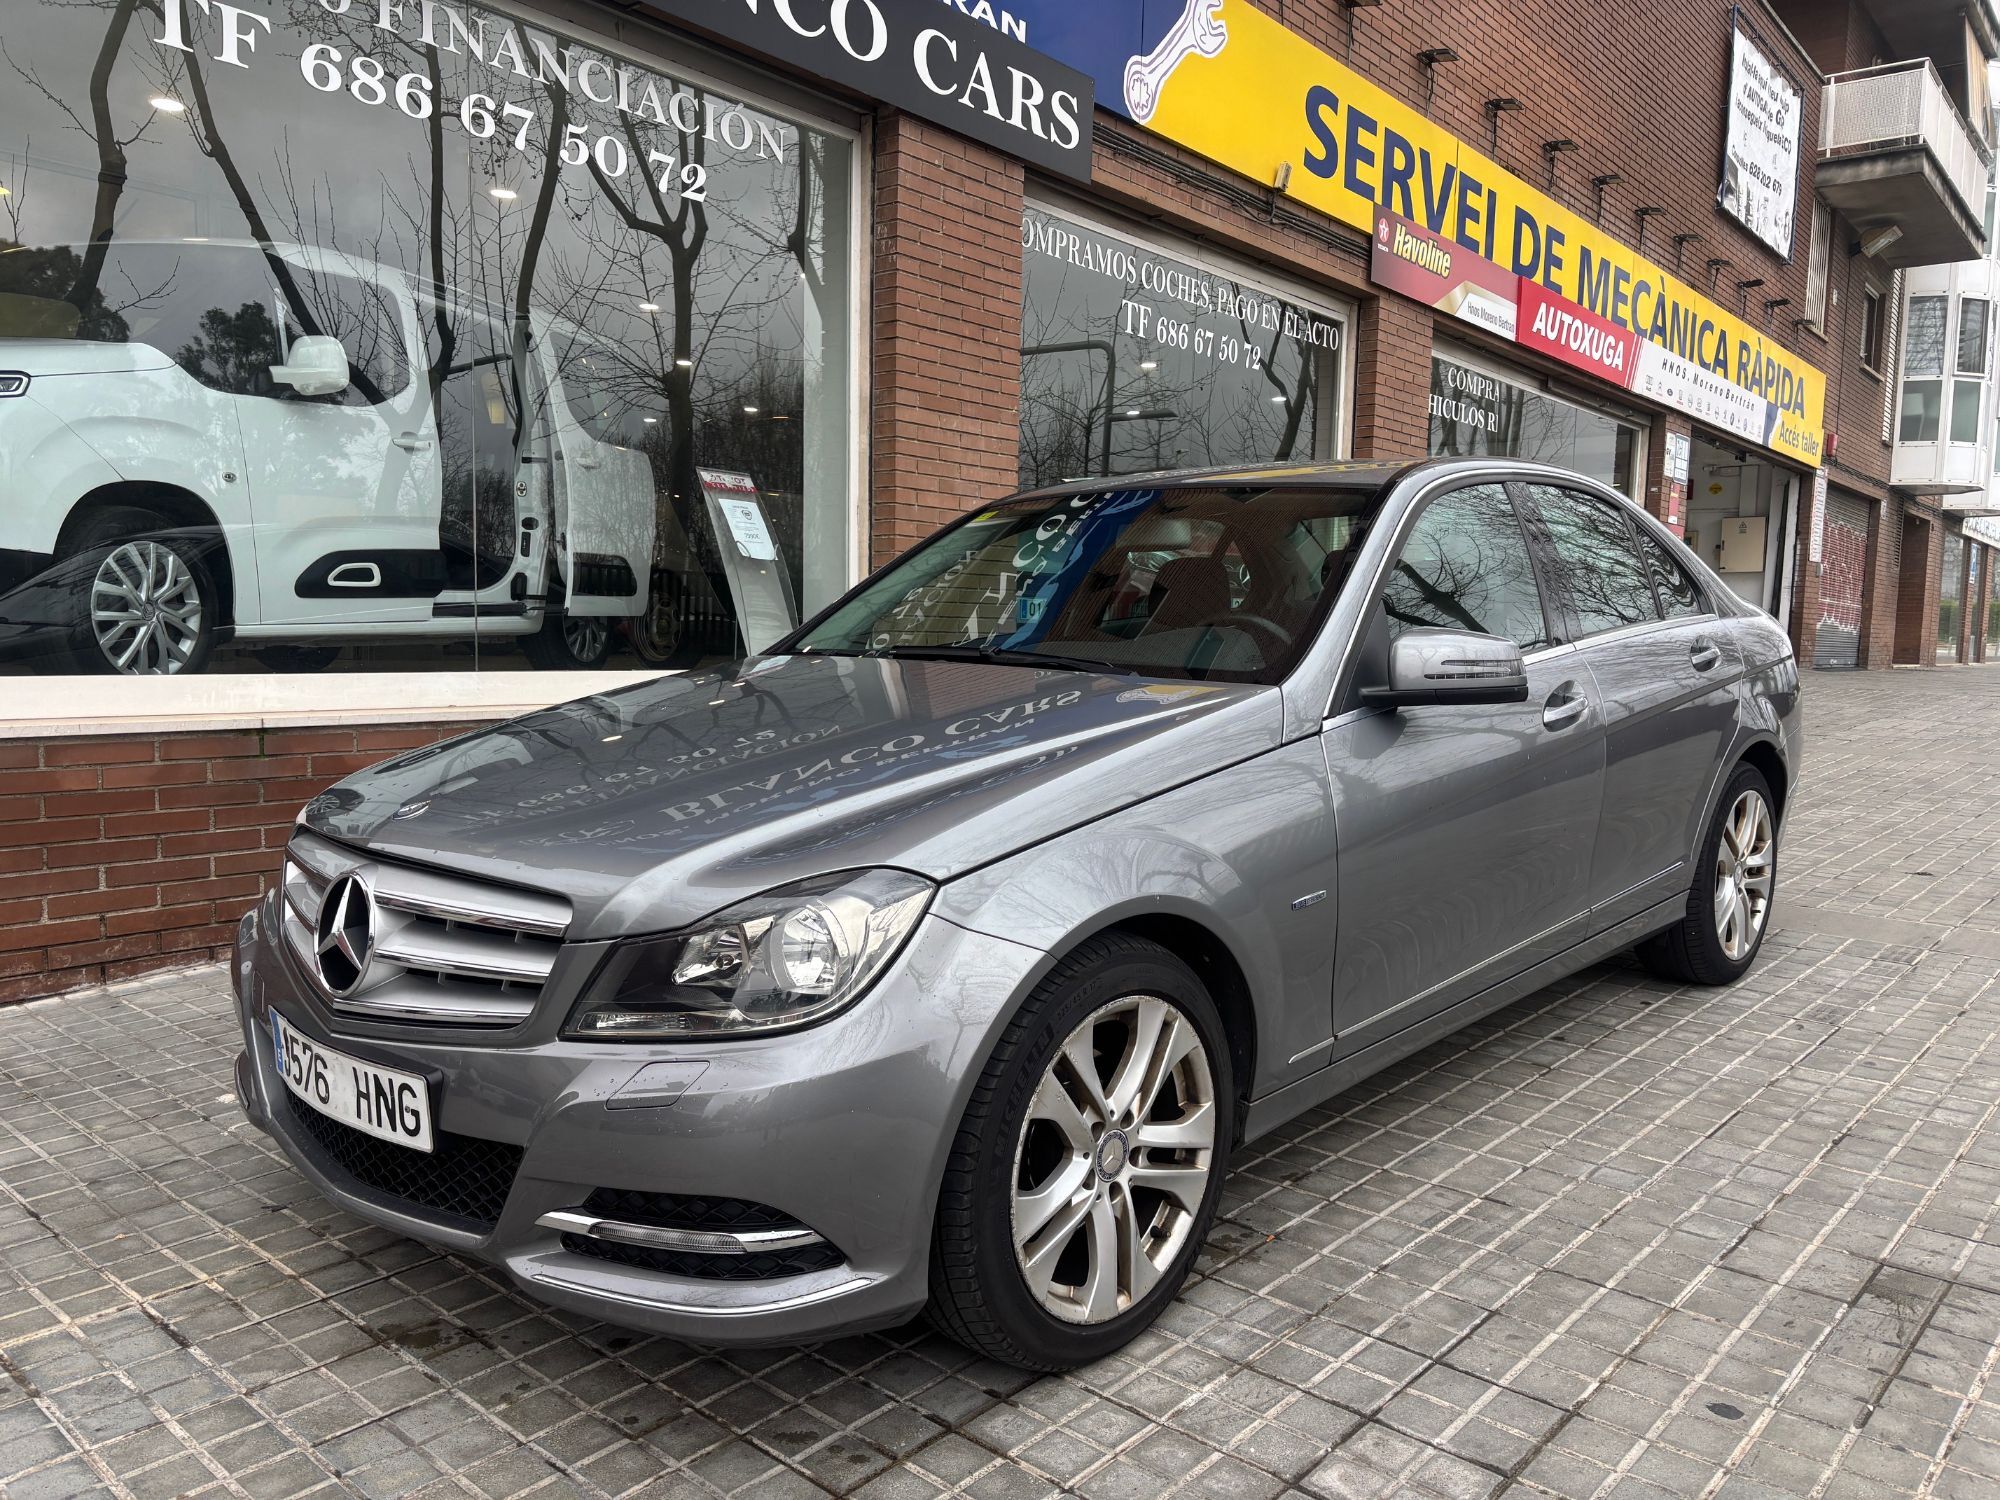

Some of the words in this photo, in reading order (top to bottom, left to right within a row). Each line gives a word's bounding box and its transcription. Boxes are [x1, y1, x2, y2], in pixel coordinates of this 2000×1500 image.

[154, 0, 271, 69] TF
[300, 43, 433, 119] 686
[460, 93, 534, 151] 67
[559, 123, 627, 178] 50
[648, 148, 707, 202] 72
[373, 0, 788, 165] FINANCIACIÓN
[913, 28, 1080, 150] CARS
[1303, 85, 1497, 261] SERVEI
[1511, 205, 1566, 294] DE
[1577, 245, 1729, 380] MECÀNICA
[1736, 337, 1805, 419] RÀPIDA
[1393, 222, 1451, 278] Havoline
[1121, 299, 1152, 339] TF
[1156, 317, 1188, 350] 686
[1194, 328, 1214, 354] 67
[1218, 335, 1238, 363] 50
[1243, 343, 1261, 371] 72
[1141, 262, 1213, 314] COCHES,
[1217, 287, 1258, 324] PAGO
[1260, 304, 1282, 332] EN
[1284, 311, 1302, 339] EL
[1303, 322, 1339, 350] ACTO
[1531, 302, 1625, 372] AUTOXUGA
[1692, 372, 1724, 397] Moreno
[1779, 421, 1800, 447] Accés
[1801, 429, 1819, 457] taller
[352, 1067, 421, 1138] HNG
